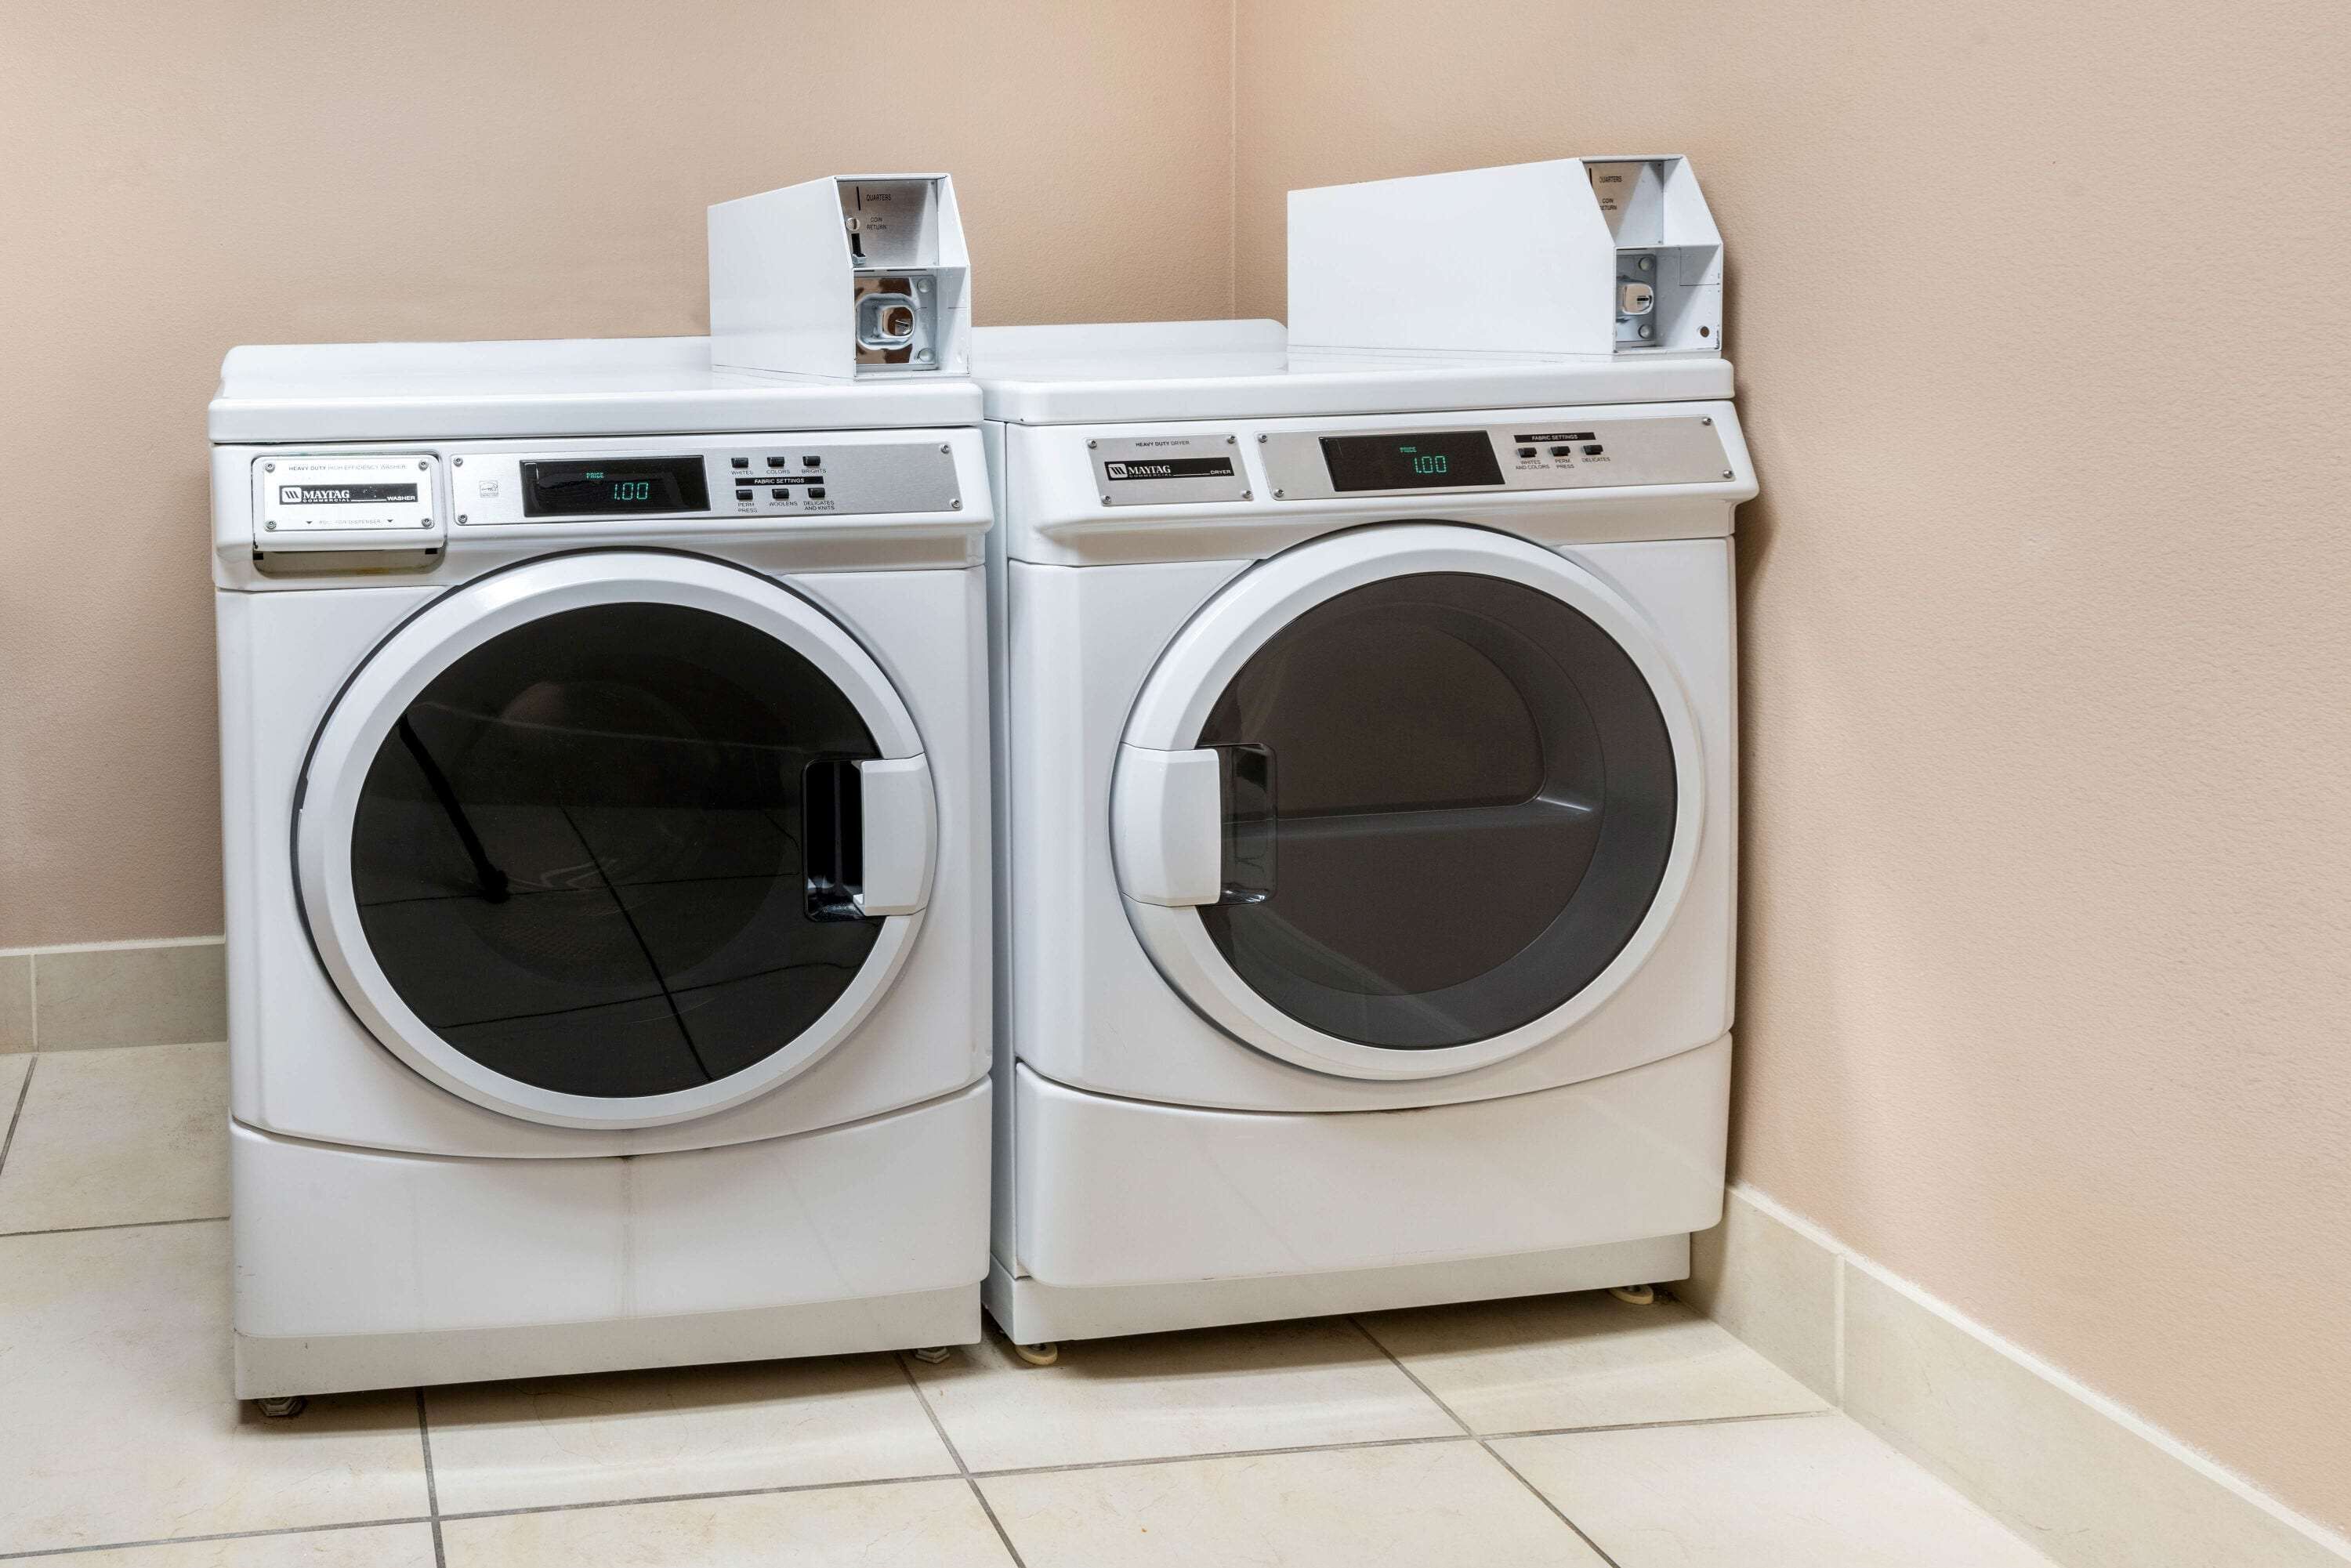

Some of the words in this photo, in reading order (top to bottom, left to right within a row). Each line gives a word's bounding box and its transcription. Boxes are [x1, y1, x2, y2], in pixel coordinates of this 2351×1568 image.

[1128, 465, 1171, 474] MAYTAG
[1414, 456, 1447, 473] 1.00
[302, 490, 350, 498] MAYTAG
[614, 482, 649, 500] 1.00
